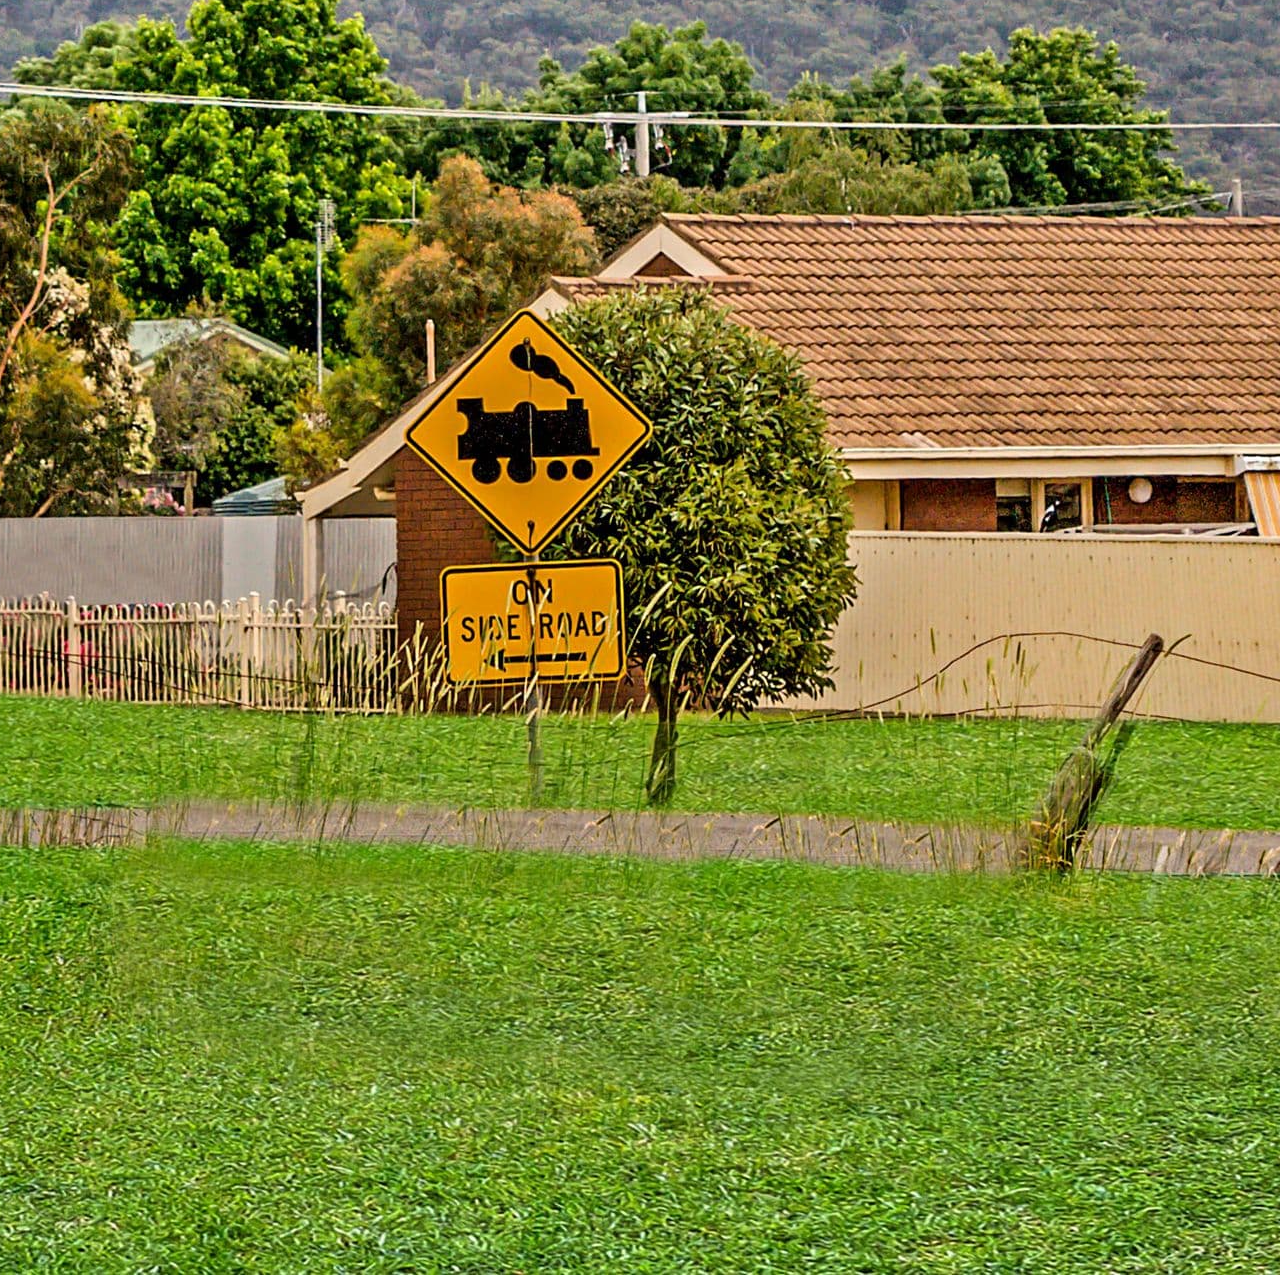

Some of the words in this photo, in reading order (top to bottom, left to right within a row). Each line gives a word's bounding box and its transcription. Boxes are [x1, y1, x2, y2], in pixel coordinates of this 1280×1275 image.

[512, 579, 552, 605] ON
[461, 614, 520, 642] SIDE
[539, 611, 606, 639] ROAD
